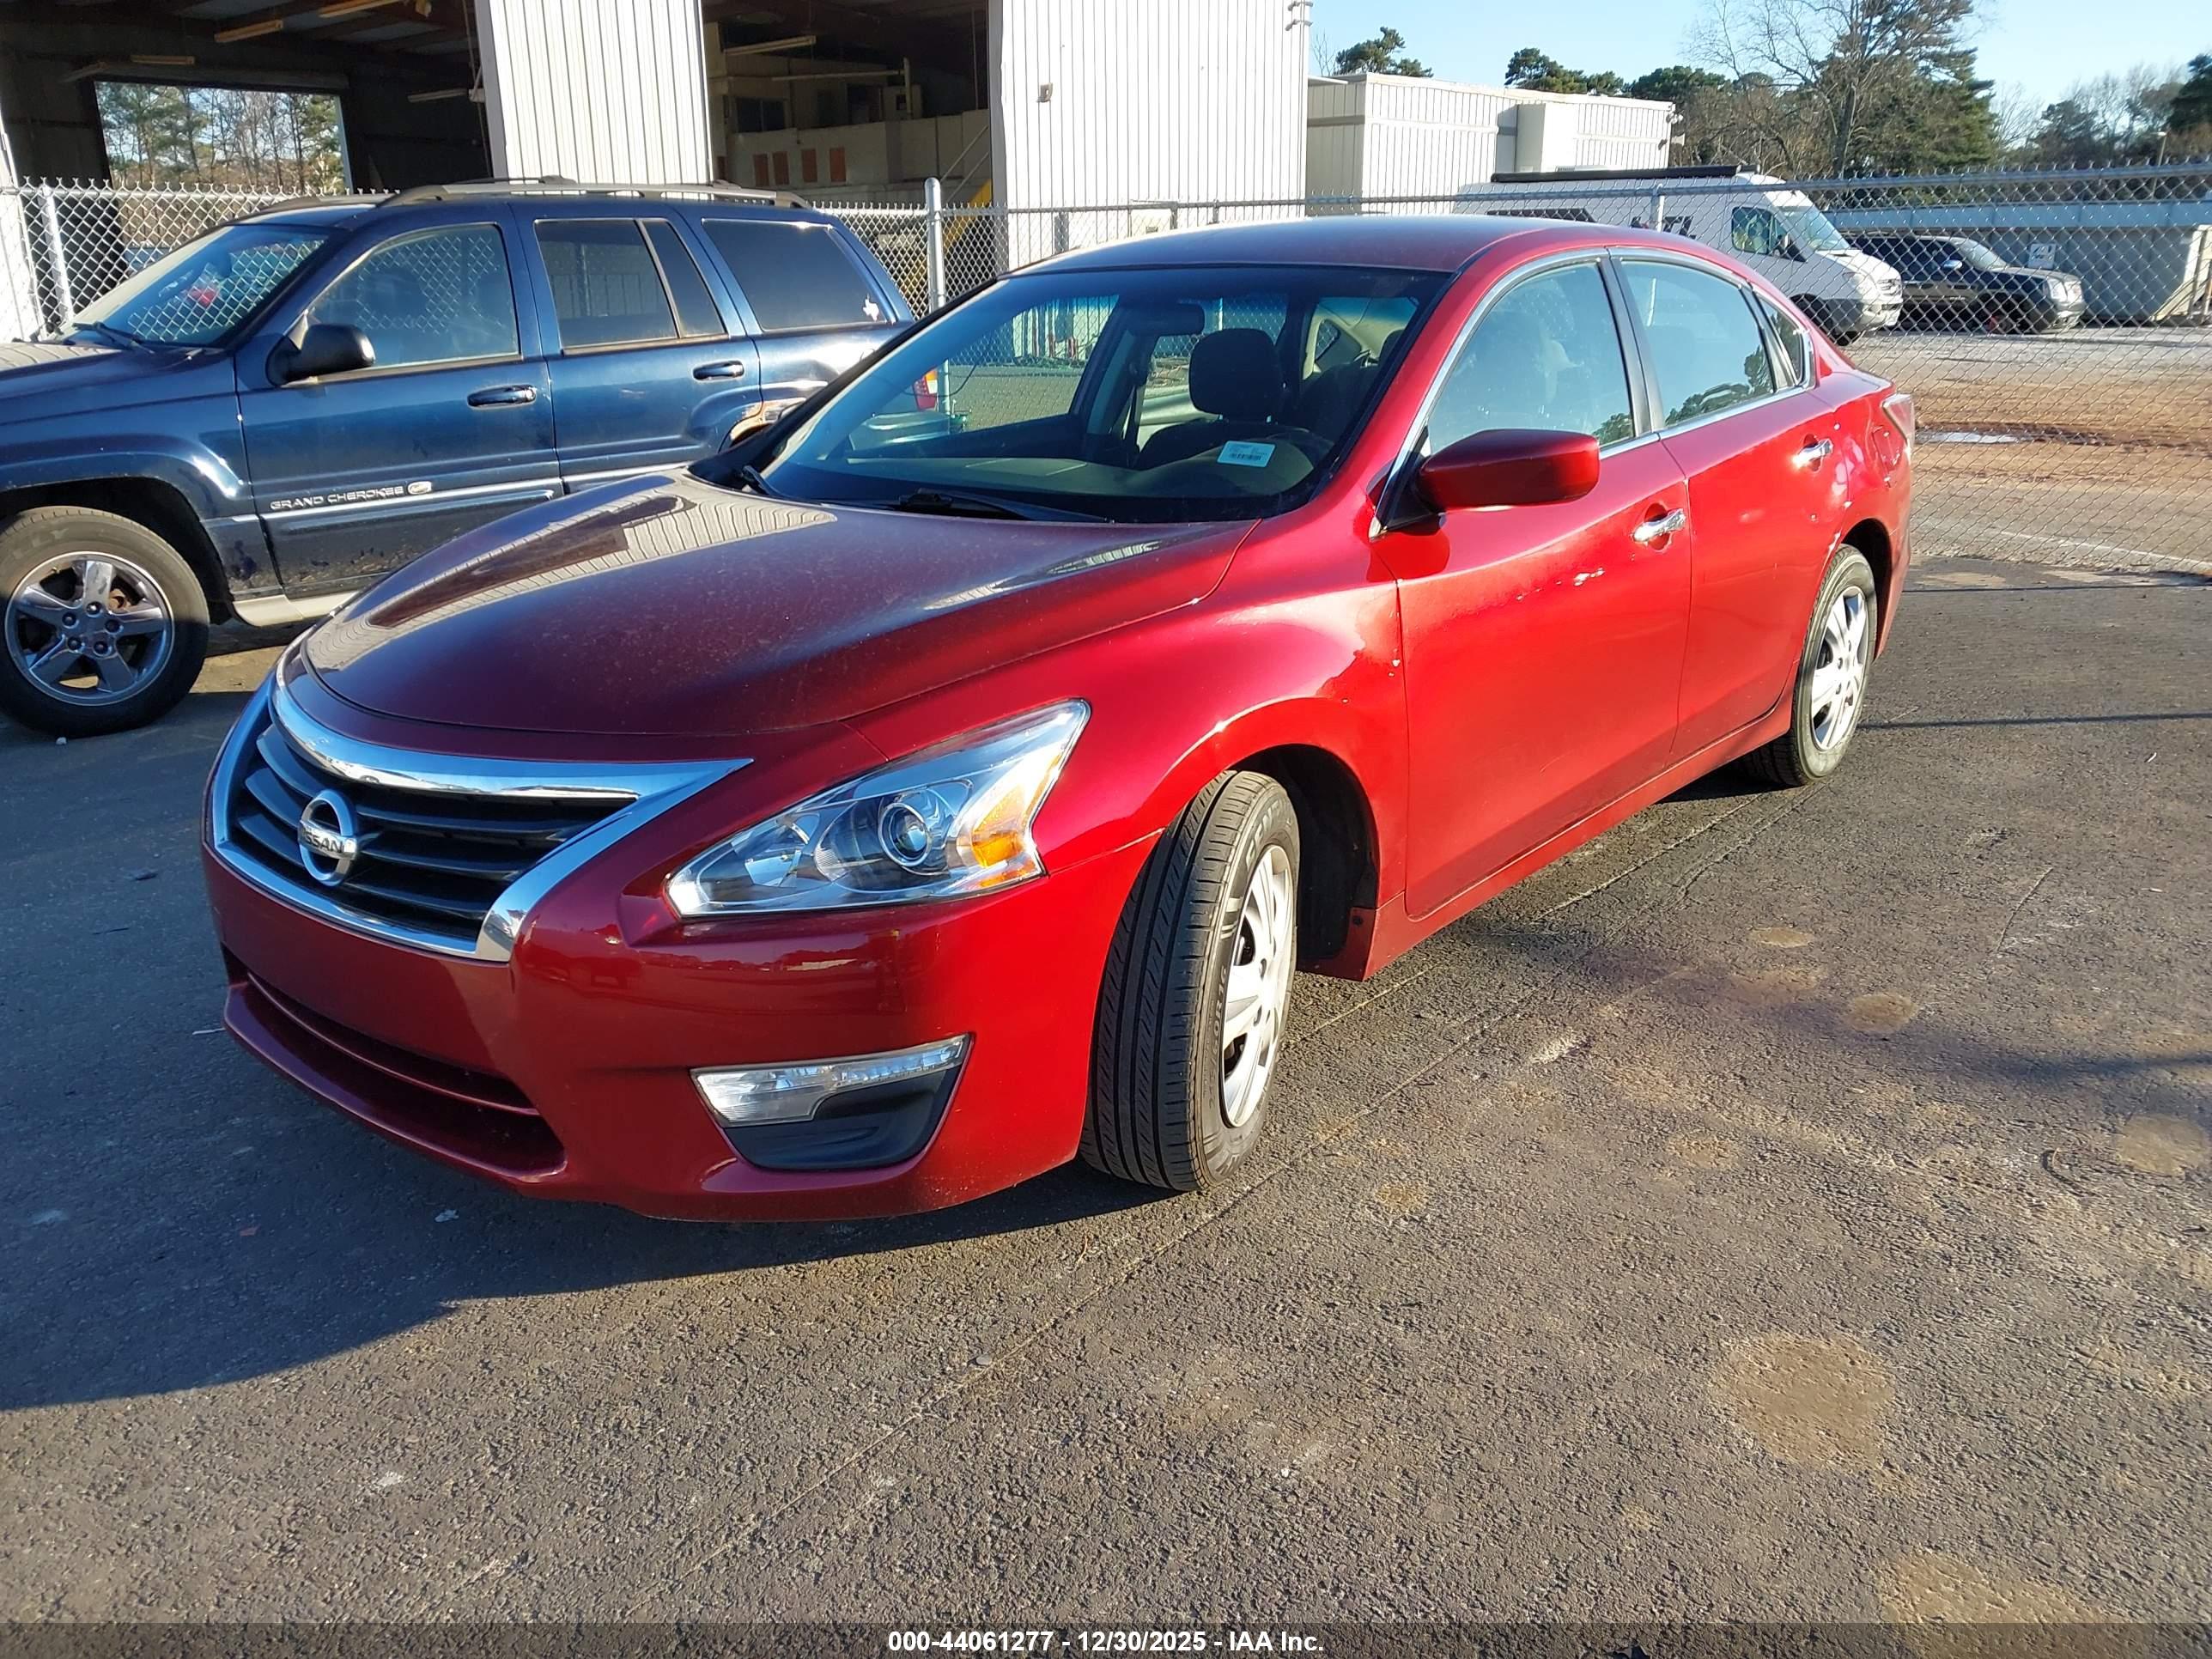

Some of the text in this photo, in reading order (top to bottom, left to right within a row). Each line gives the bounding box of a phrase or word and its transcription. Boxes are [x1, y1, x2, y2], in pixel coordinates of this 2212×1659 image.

[270, 495, 324, 511] GRAND
[327, 485, 404, 504] CHEROKEE
[302, 826, 343, 854] SSAN
